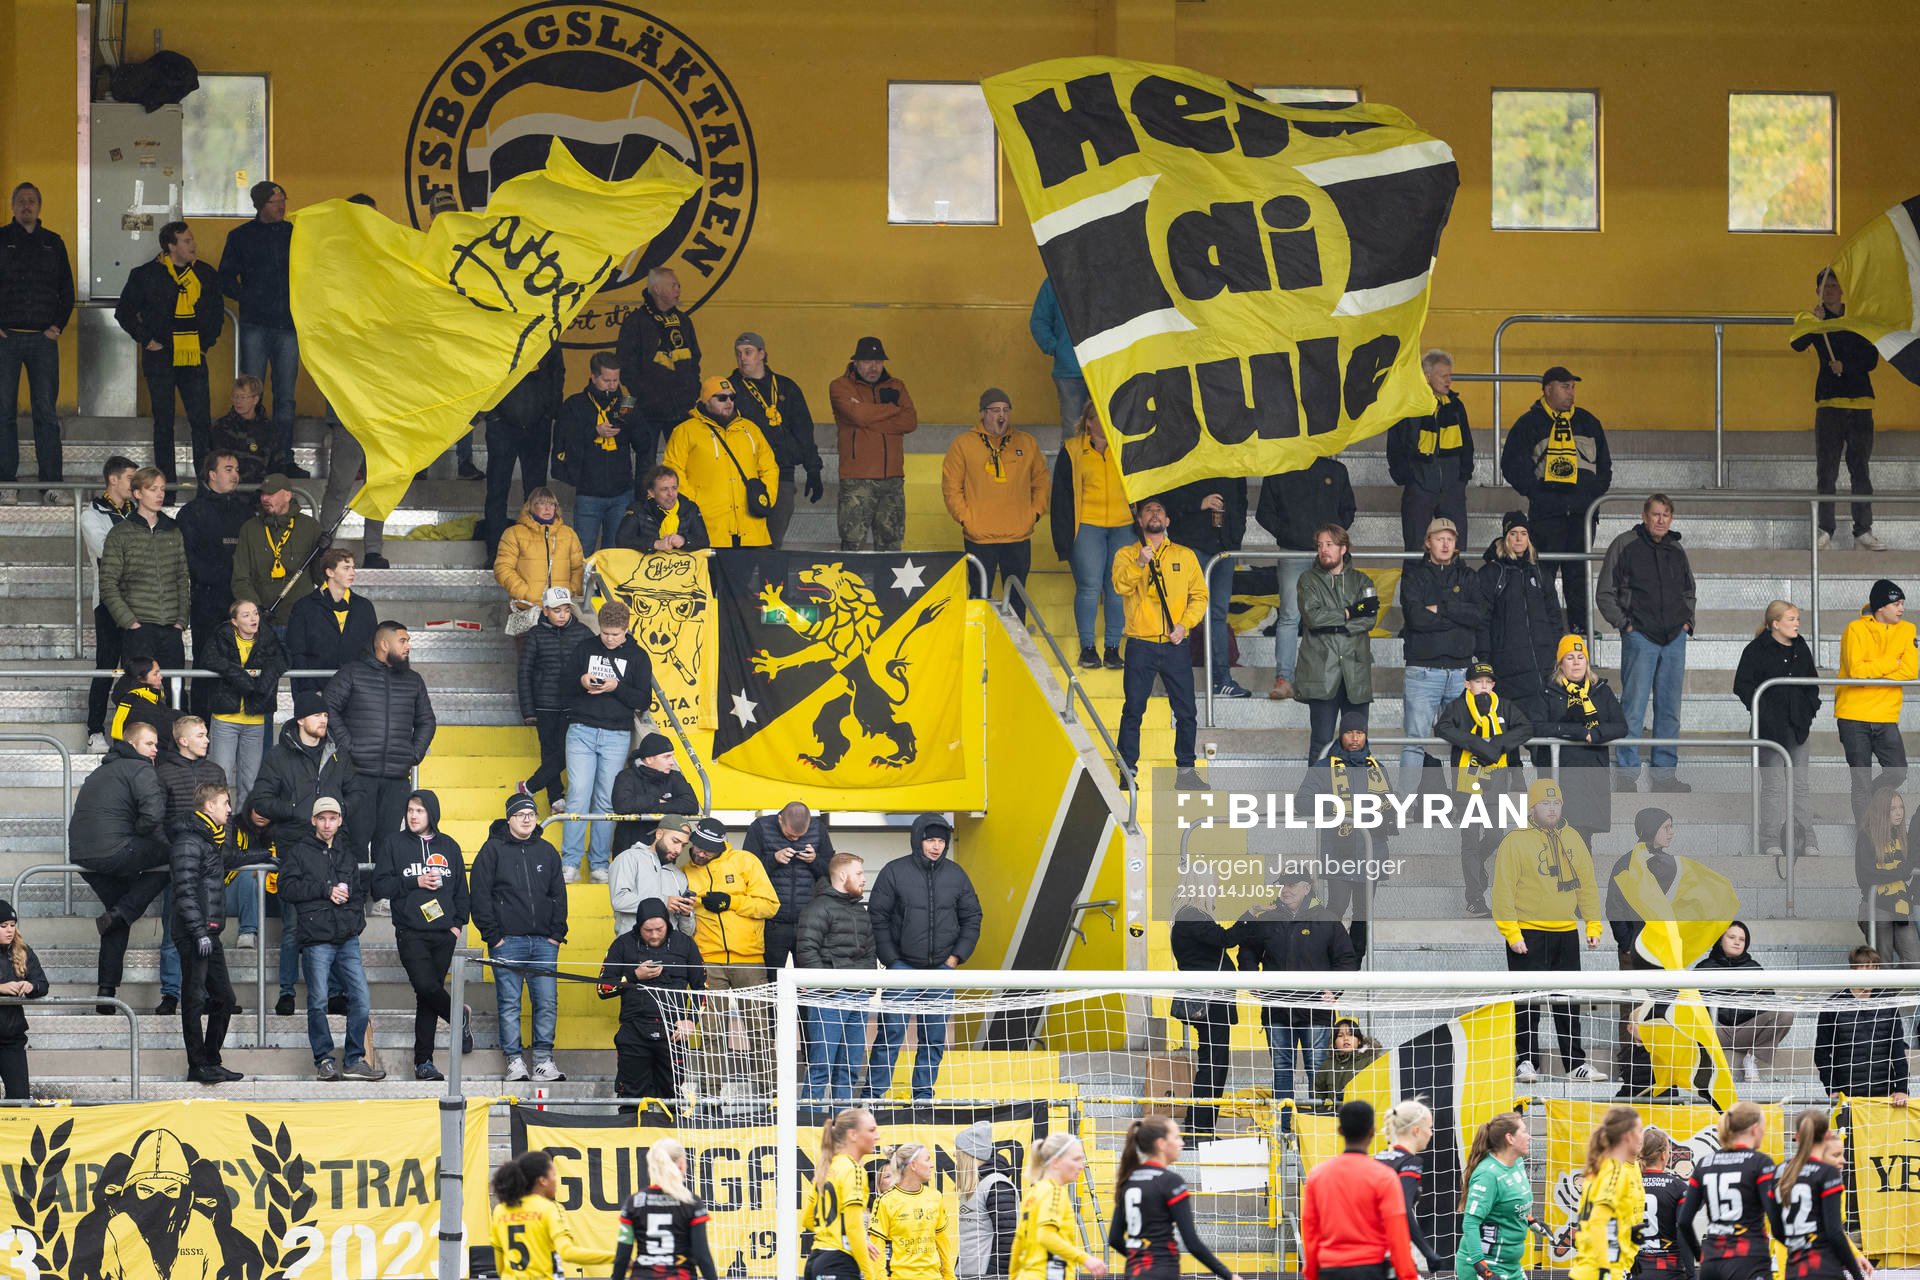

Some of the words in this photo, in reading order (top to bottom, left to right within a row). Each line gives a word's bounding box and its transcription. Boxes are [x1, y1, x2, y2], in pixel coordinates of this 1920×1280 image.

[418, 11, 745, 278] FSBORGSLÄKTAREN
[1013, 72, 1390, 188] Hej
[1109, 334, 1400, 476] gule
[403, 863, 452, 877] ellese
[1124, 1187, 1143, 1237] 6
[1703, 1171, 1744, 1222] 15
[508, 1224, 530, 1271] 5
[646, 1213, 675, 1254] 5
